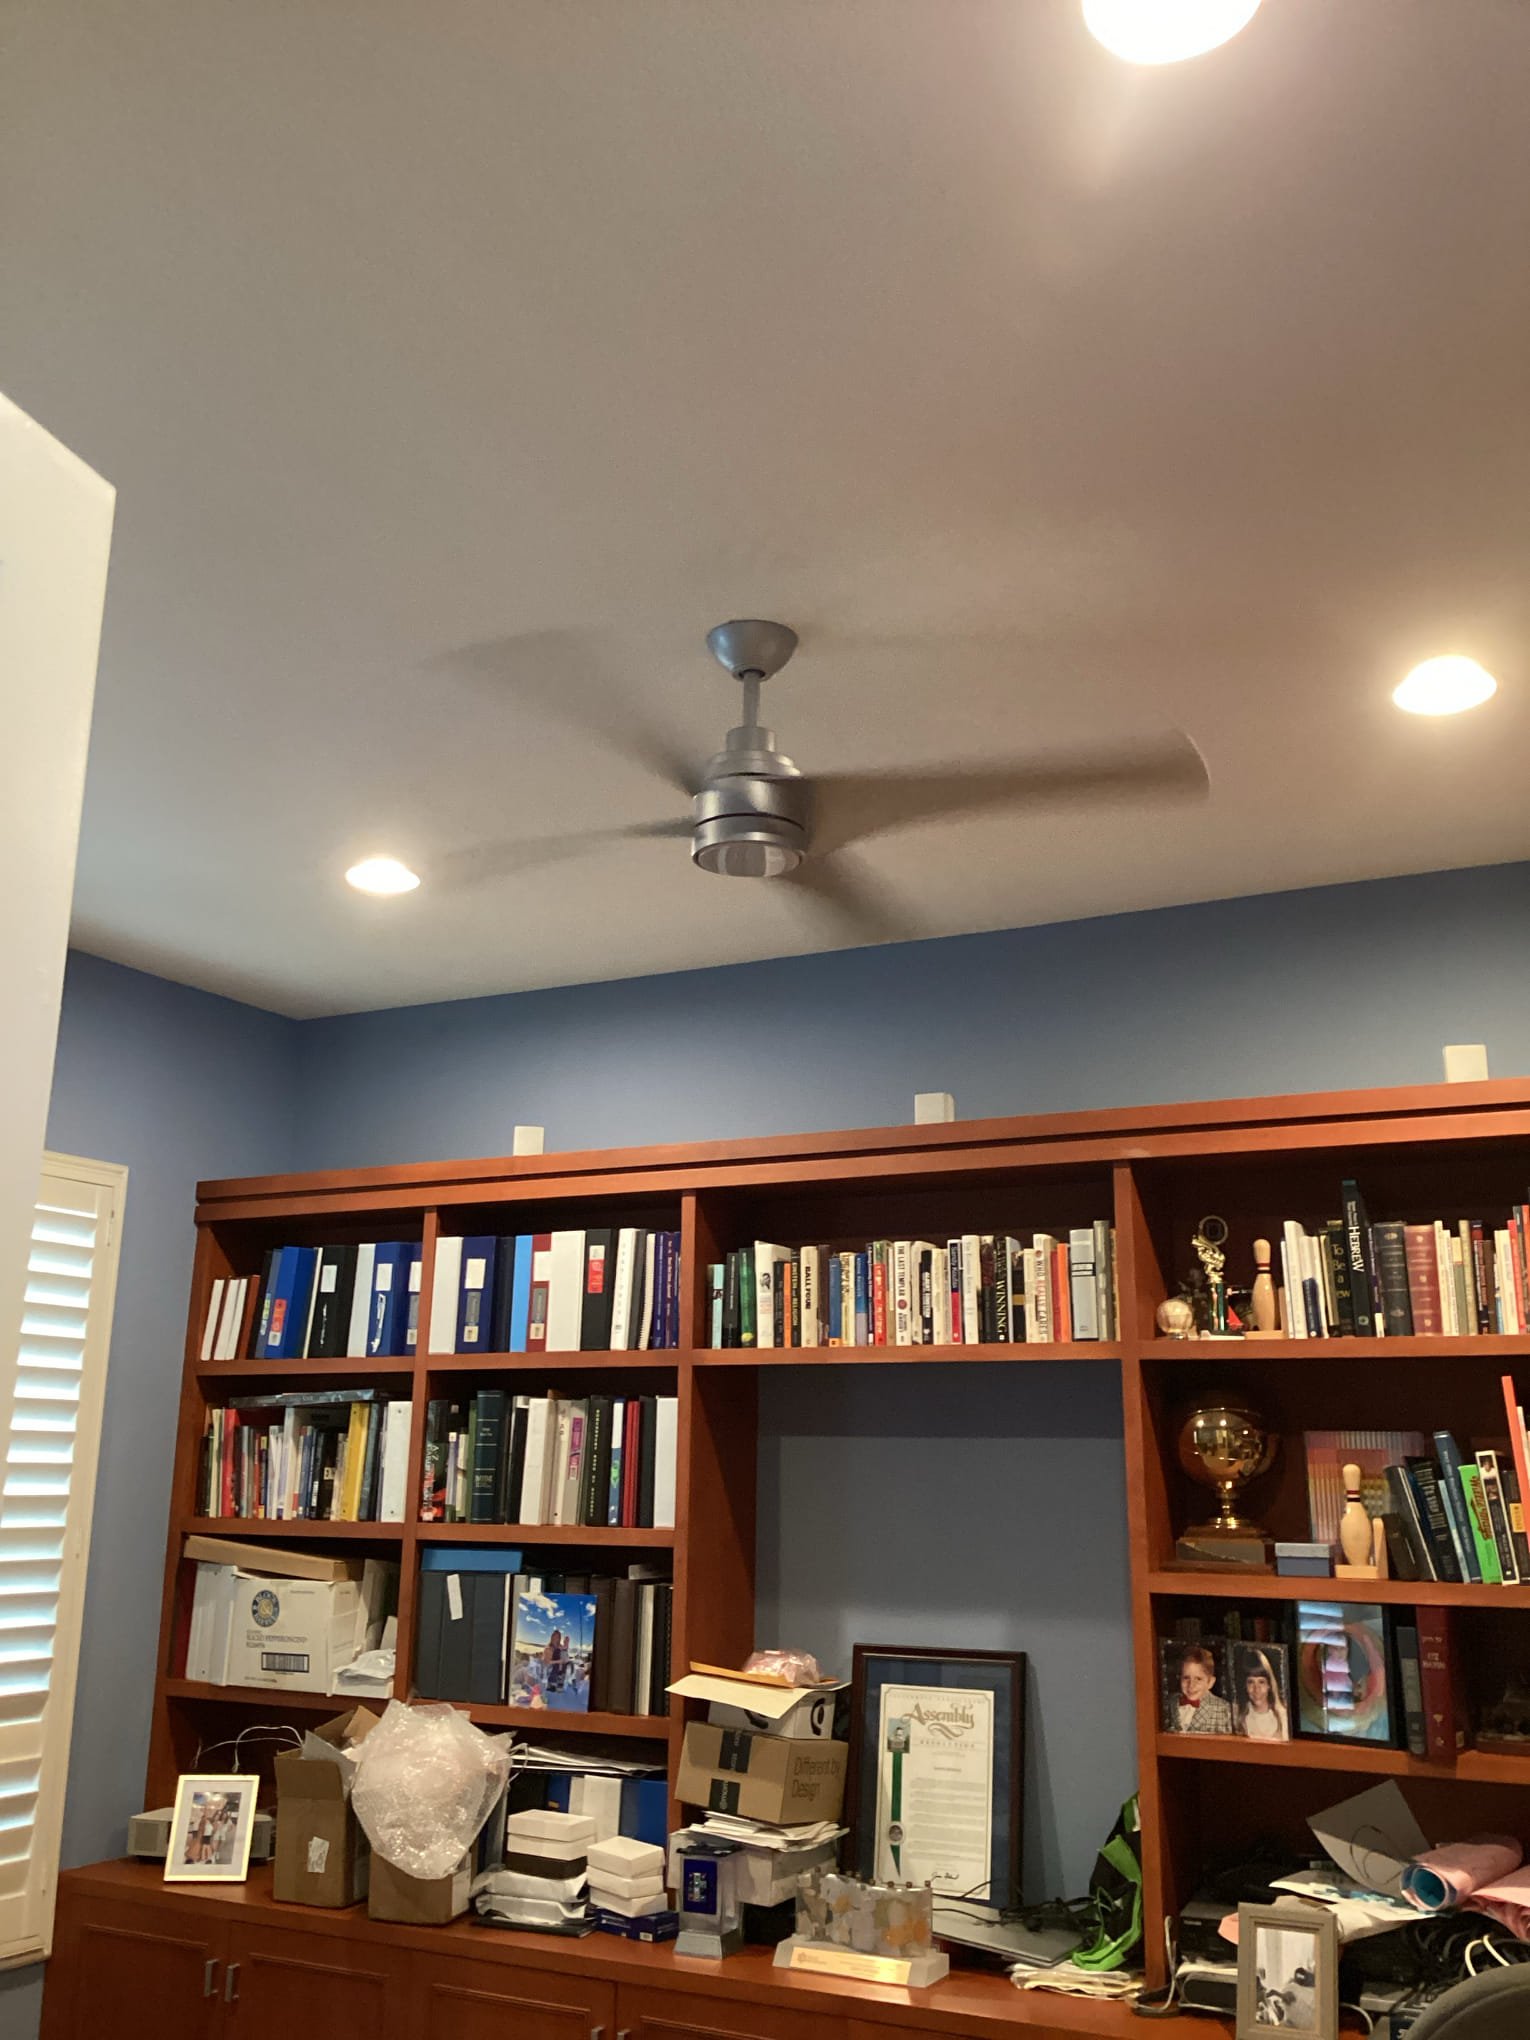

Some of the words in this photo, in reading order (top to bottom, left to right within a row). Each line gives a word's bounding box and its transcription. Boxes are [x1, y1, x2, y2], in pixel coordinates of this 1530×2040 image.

[951, 1246, 959, 1266] Sandy
[1331, 1244, 1344, 1255] To
[1348, 1226, 1365, 1272] HEBREW
[1036, 1260, 1045, 1277] WHO
[996, 1279, 1007, 1333] WINNING
[901, 1702, 975, 1730] Assembly
[793, 1756, 829, 1776] Different
[791, 1779, 821, 1802] Design
